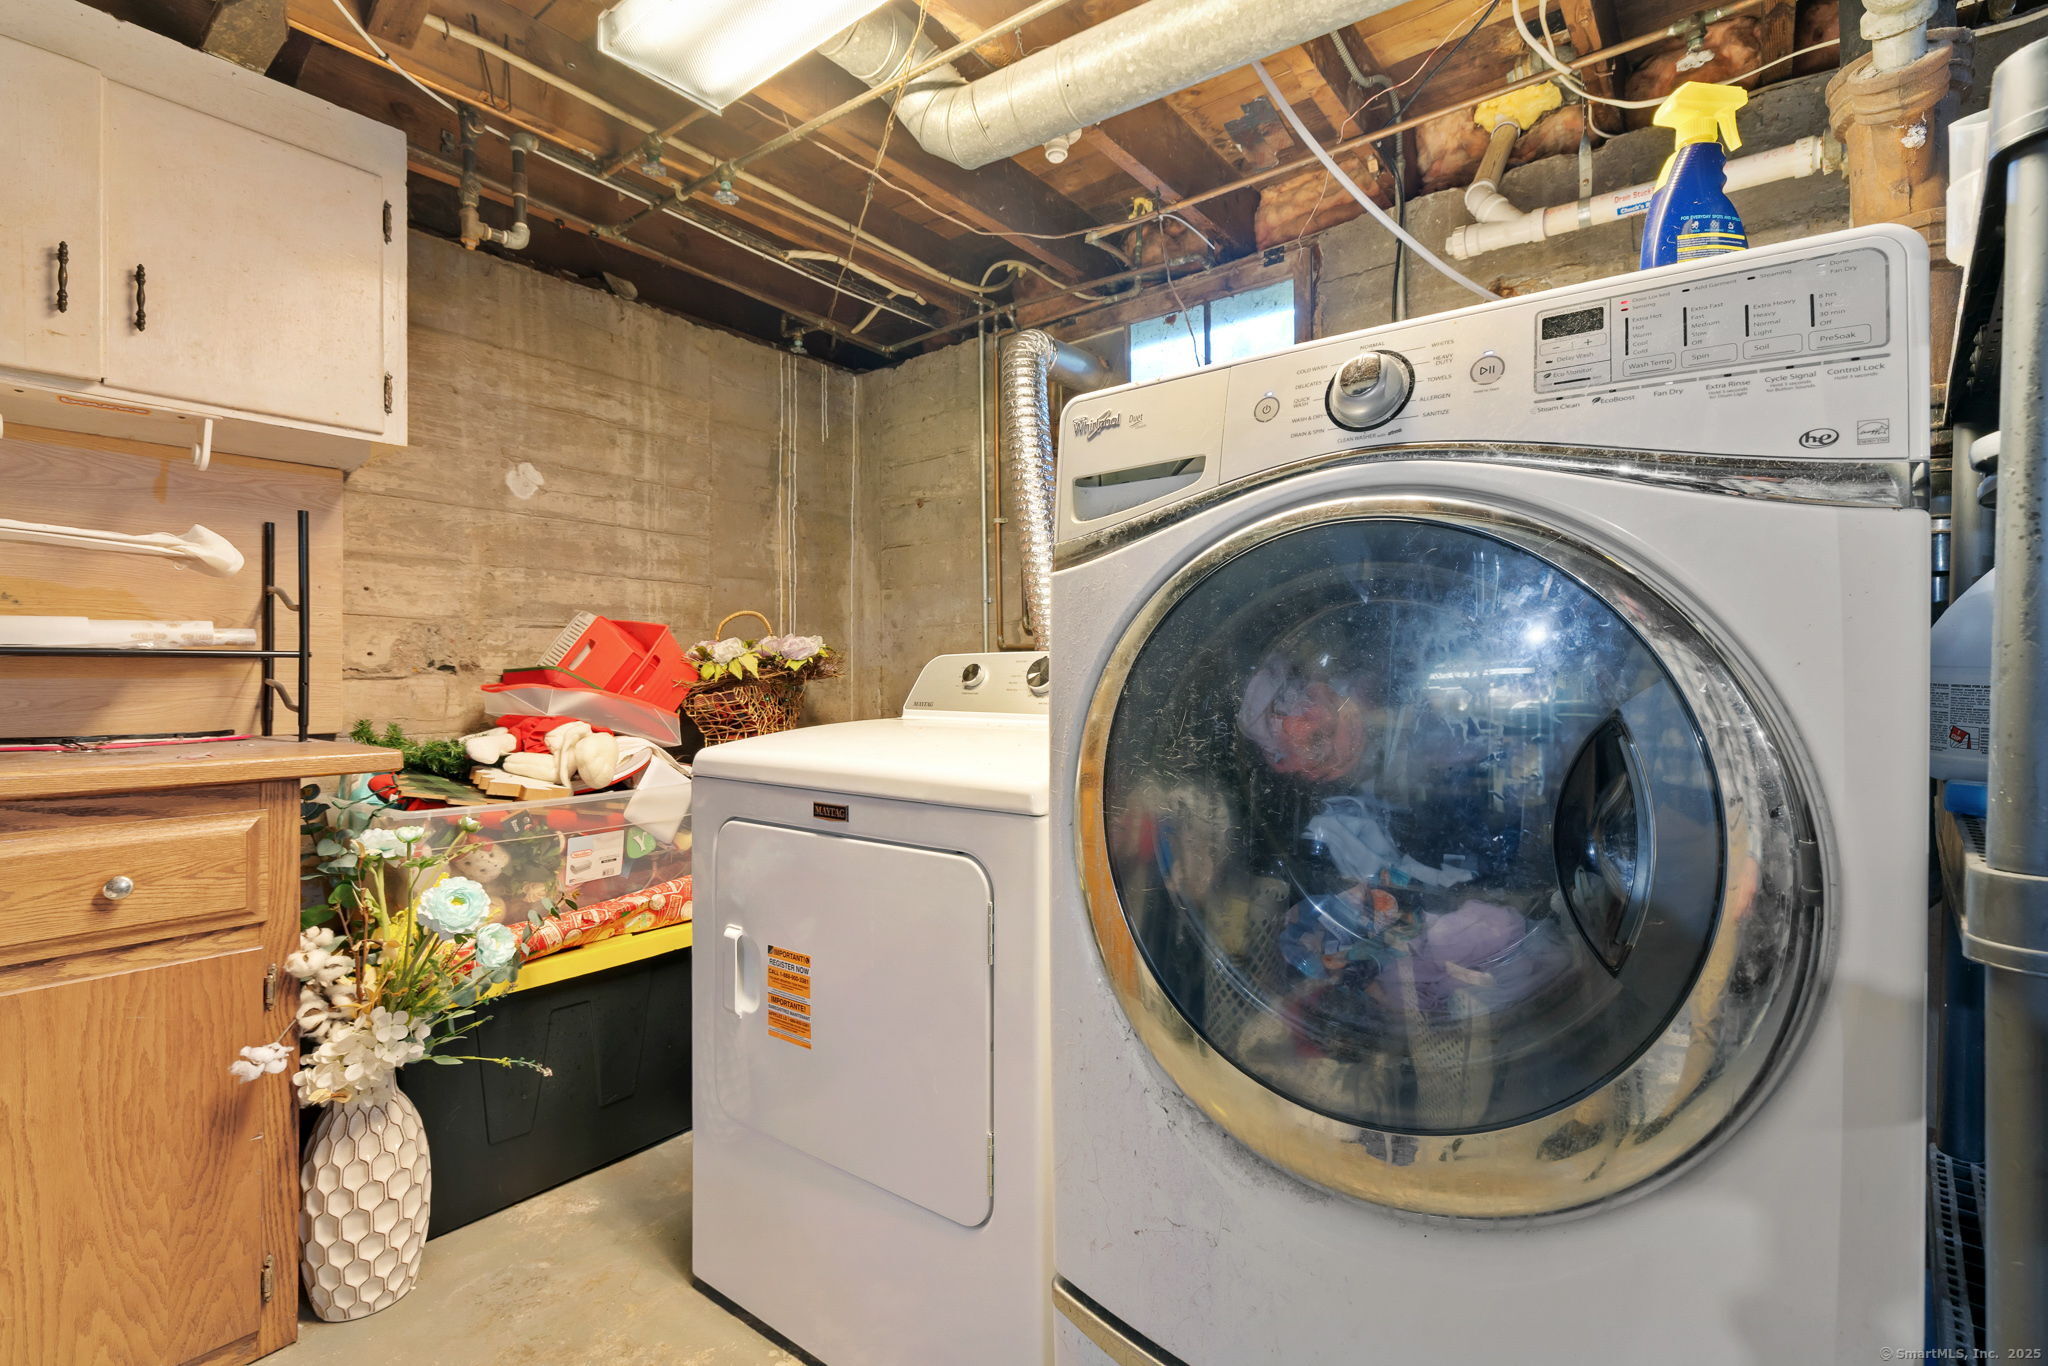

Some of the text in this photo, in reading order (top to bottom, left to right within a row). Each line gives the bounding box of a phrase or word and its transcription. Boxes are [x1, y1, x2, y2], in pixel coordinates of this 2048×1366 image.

[1829, 258, 1849, 266] Done
[1844, 265, 1857, 273] Dry
[1760, 269, 1792, 279] Steaming
[1709, 280, 1737, 288] Garment
[1753, 298, 1796, 310] Extra Heavy
[1753, 310, 1776, 319] Heavy
[1831, 308, 1846, 316] min
[1691, 320, 1720, 329] Medium
[1753, 318, 1781, 327] Normal
[1753, 328, 1773, 337] Light
[1820, 331, 1856, 342] PreSoak
[1360, 341, 1385, 350] NORMAL
[1431, 339, 1455, 348] WHITES
[1754, 343, 1769, 351] Soil
[1556, 351, 1594, 363] Delay Wash
[1691, 352, 1710, 362] Spin
[1435, 358, 1453, 366] DUTY
[1628, 358, 1673, 370] Wash Temp
[1296, 364, 1328, 375] COLD WASH
[1567, 367, 1593, 376] Monitor
[1827, 362, 1886, 376] Control Lock
[1427, 374, 1452, 382] TOWELS
[1764, 371, 1817, 384] Cycle Signal
[1295, 380, 1322, 390] DELICATES
[1705, 379, 1751, 391] Extra Rinse
[1420, 393, 1451, 401] ALLERGEN
[1653, 388, 1684, 398] Fan Dry
[1293, 396, 1310, 404] QUICK
[1600, 394, 1635, 404] EcoBoost
[1537, 402, 1580, 413] Steam Clean
[1422, 409, 1450, 417] SANITIZE
[1129, 414, 1143, 424] Duet
[1292, 416, 1307, 424] WASH
[1073, 413, 1121, 438] Whirlpool
[1291, 431, 1307, 439] DRAIN
[1313, 427, 1325, 435] SPIN
[1337, 436, 1354, 444] CLEAN
[814, 805, 846, 818] MAYTAG
[769, 958, 810, 975] REGISTER NOW
